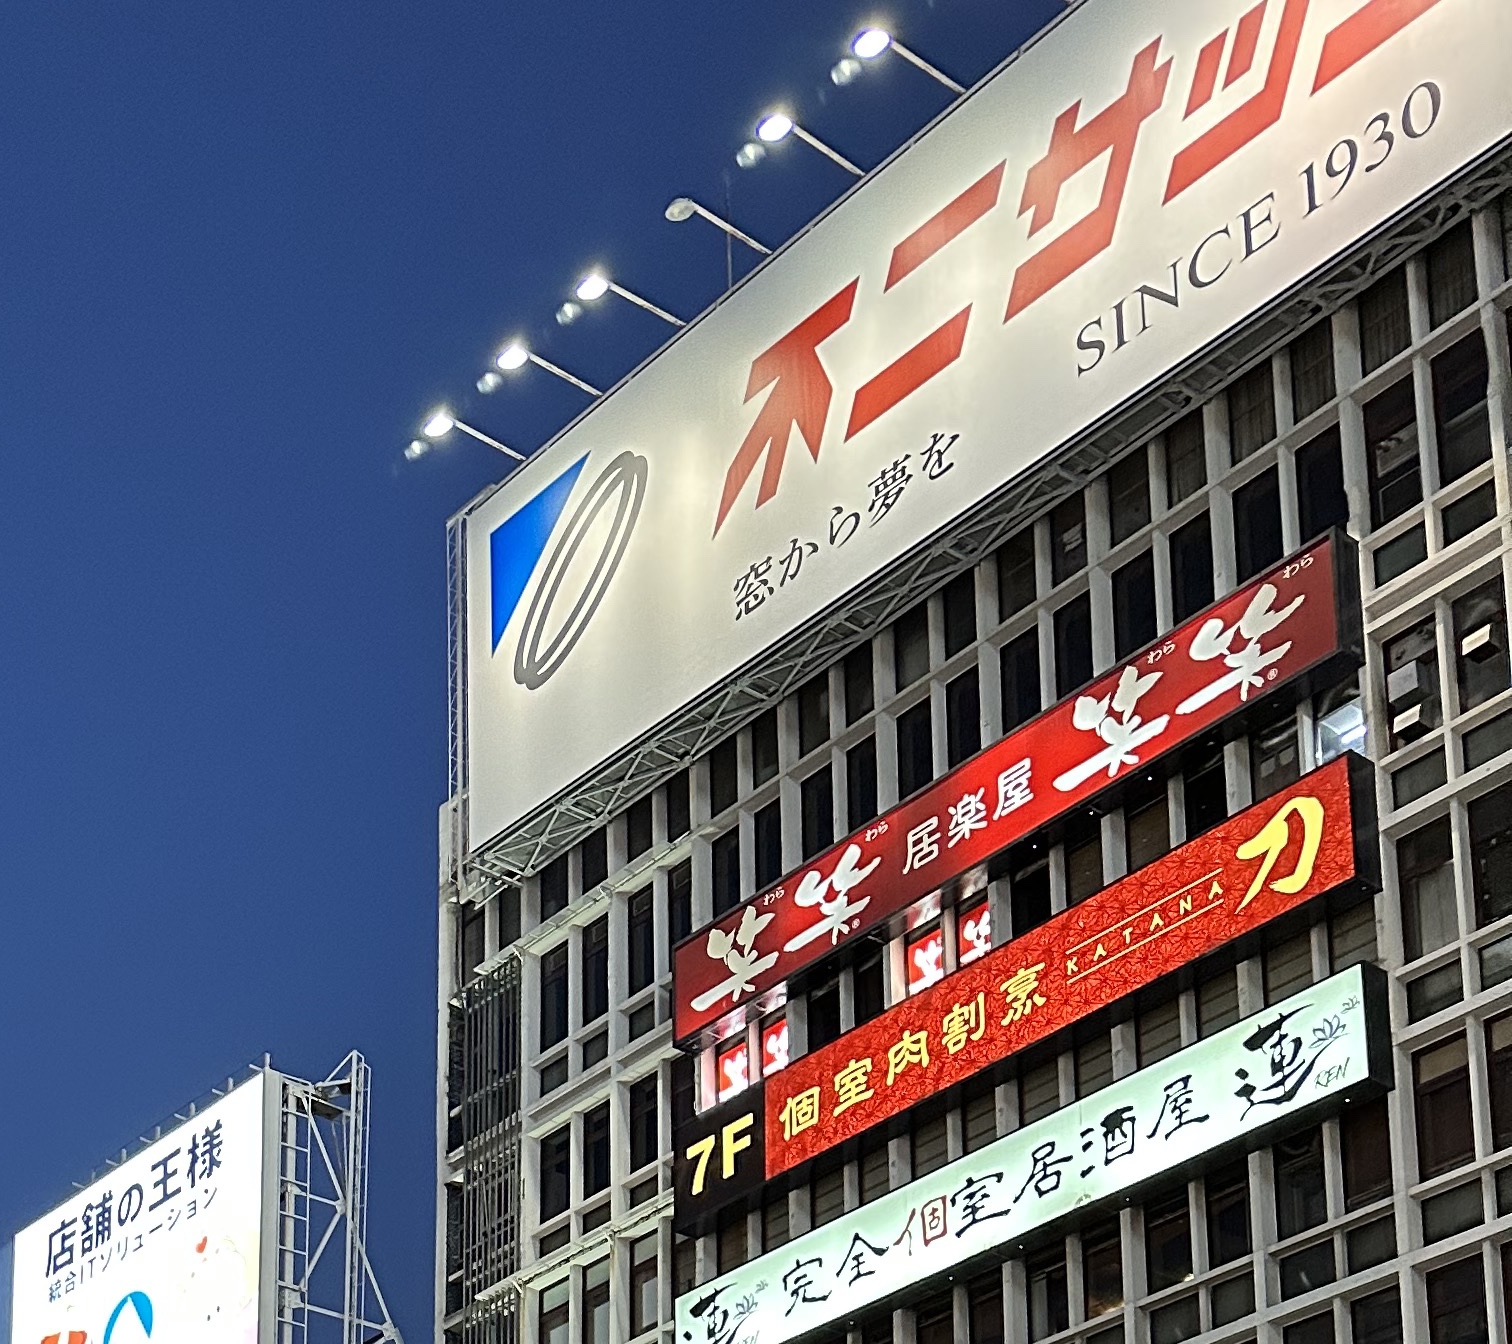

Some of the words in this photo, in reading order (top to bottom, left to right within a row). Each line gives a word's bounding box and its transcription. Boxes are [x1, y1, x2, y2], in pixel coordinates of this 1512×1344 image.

[1076, 191, 1282, 378] SINCE
[1299, 80, 1442, 220] 1930
[732, 431, 961, 623] 窓から夢を
[1281, 554, 1315, 580] わら
[903, 758, 1036, 877] 居楽屋
[1234, 796, 1325, 915] 刀
[1066, 880, 1225, 977] KATANA
[779, 961, 1050, 1141] 個室肉割烹
[45, 1120, 224, 1279] 店舗の王様
[687, 1113, 754, 1196] 7F
[783, 1074, 1210, 1317] 完全個室居酒屋
[48, 1186, 219, 1304] 統合ITソリューション
